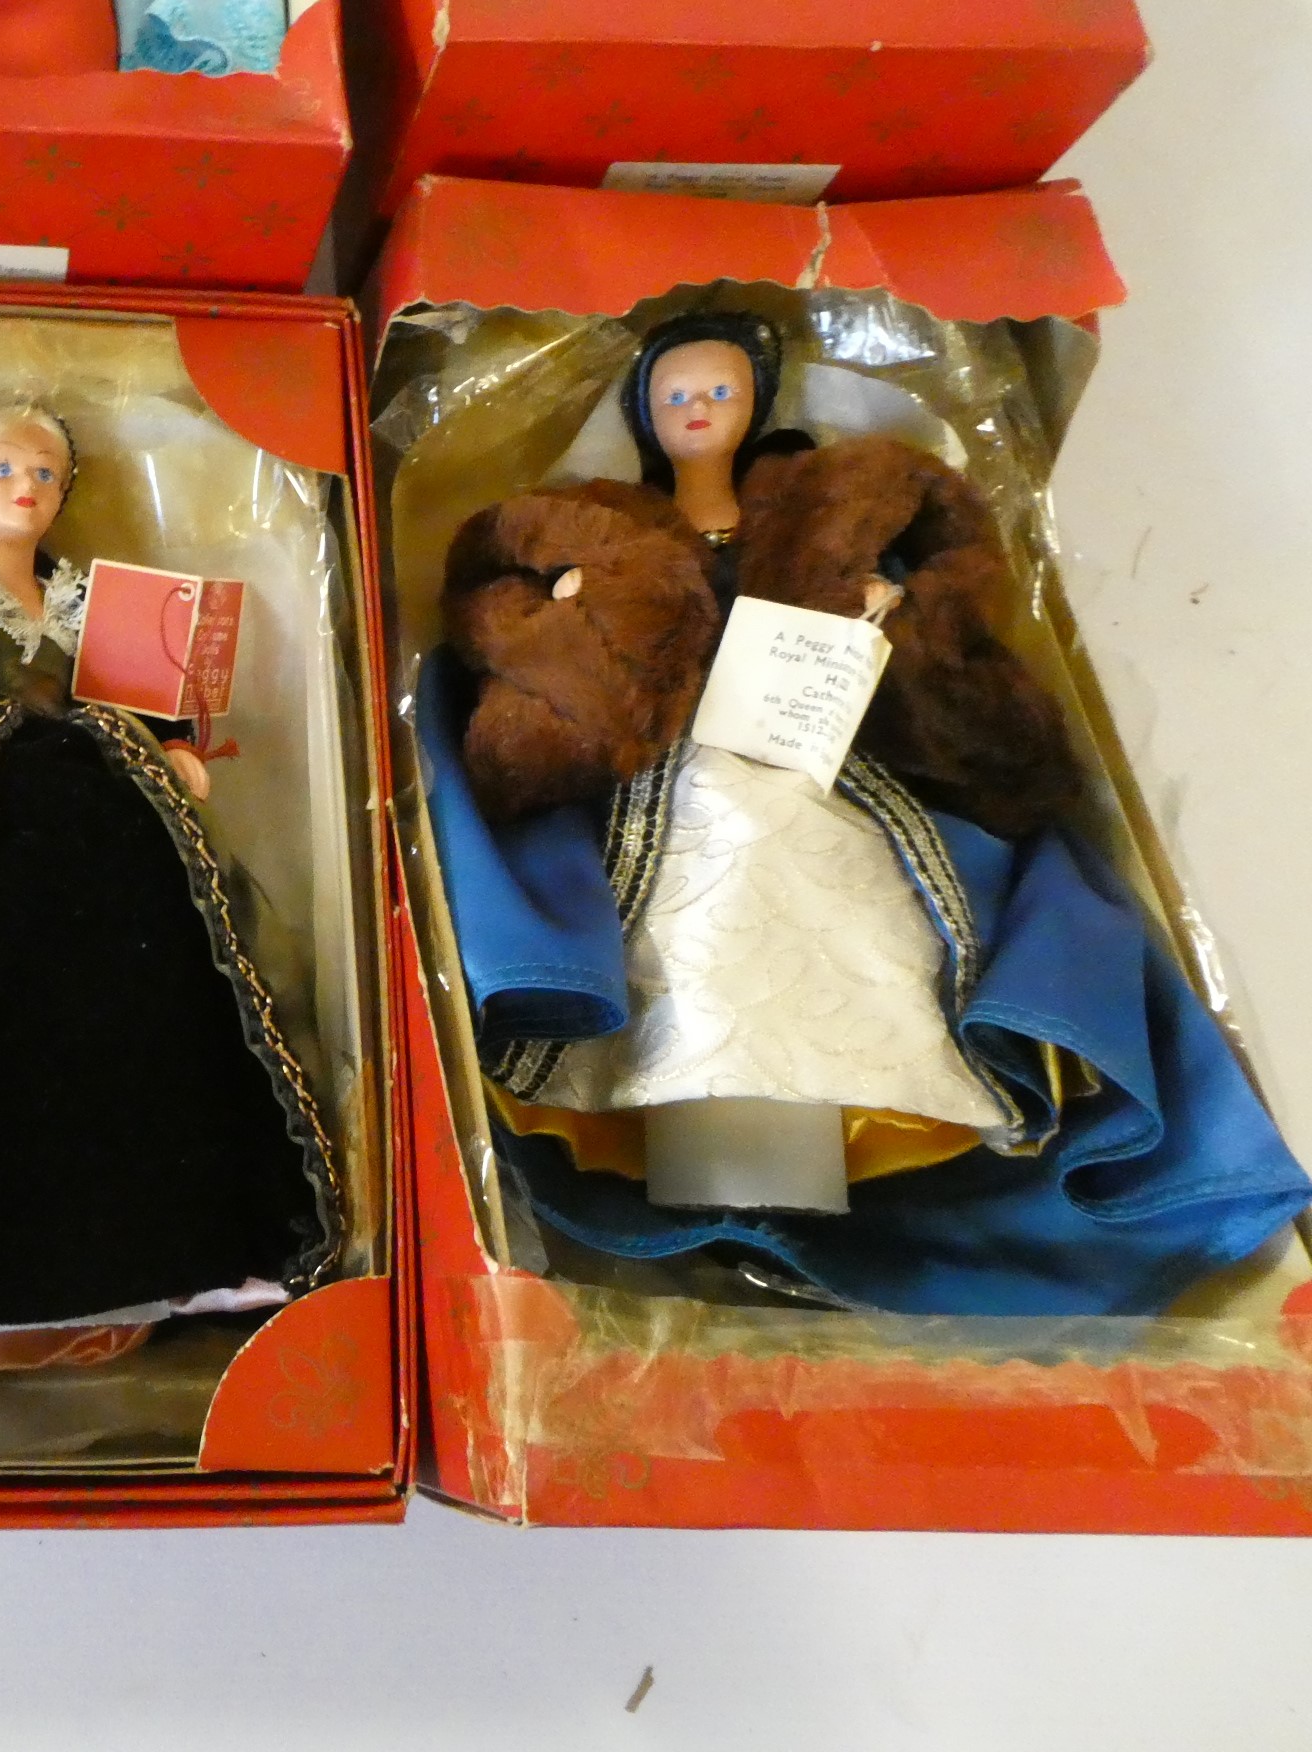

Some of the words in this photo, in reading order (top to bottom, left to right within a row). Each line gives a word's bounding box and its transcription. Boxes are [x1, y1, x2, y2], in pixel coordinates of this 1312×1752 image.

[774, 631, 785, 642] A
[795, 634, 835, 654] Peggy
[769, 646, 807, 664] Royal
[788, 698, 823, 713] Queen
[778, 708, 811, 722] whom
[768, 733, 803, 750] Made
